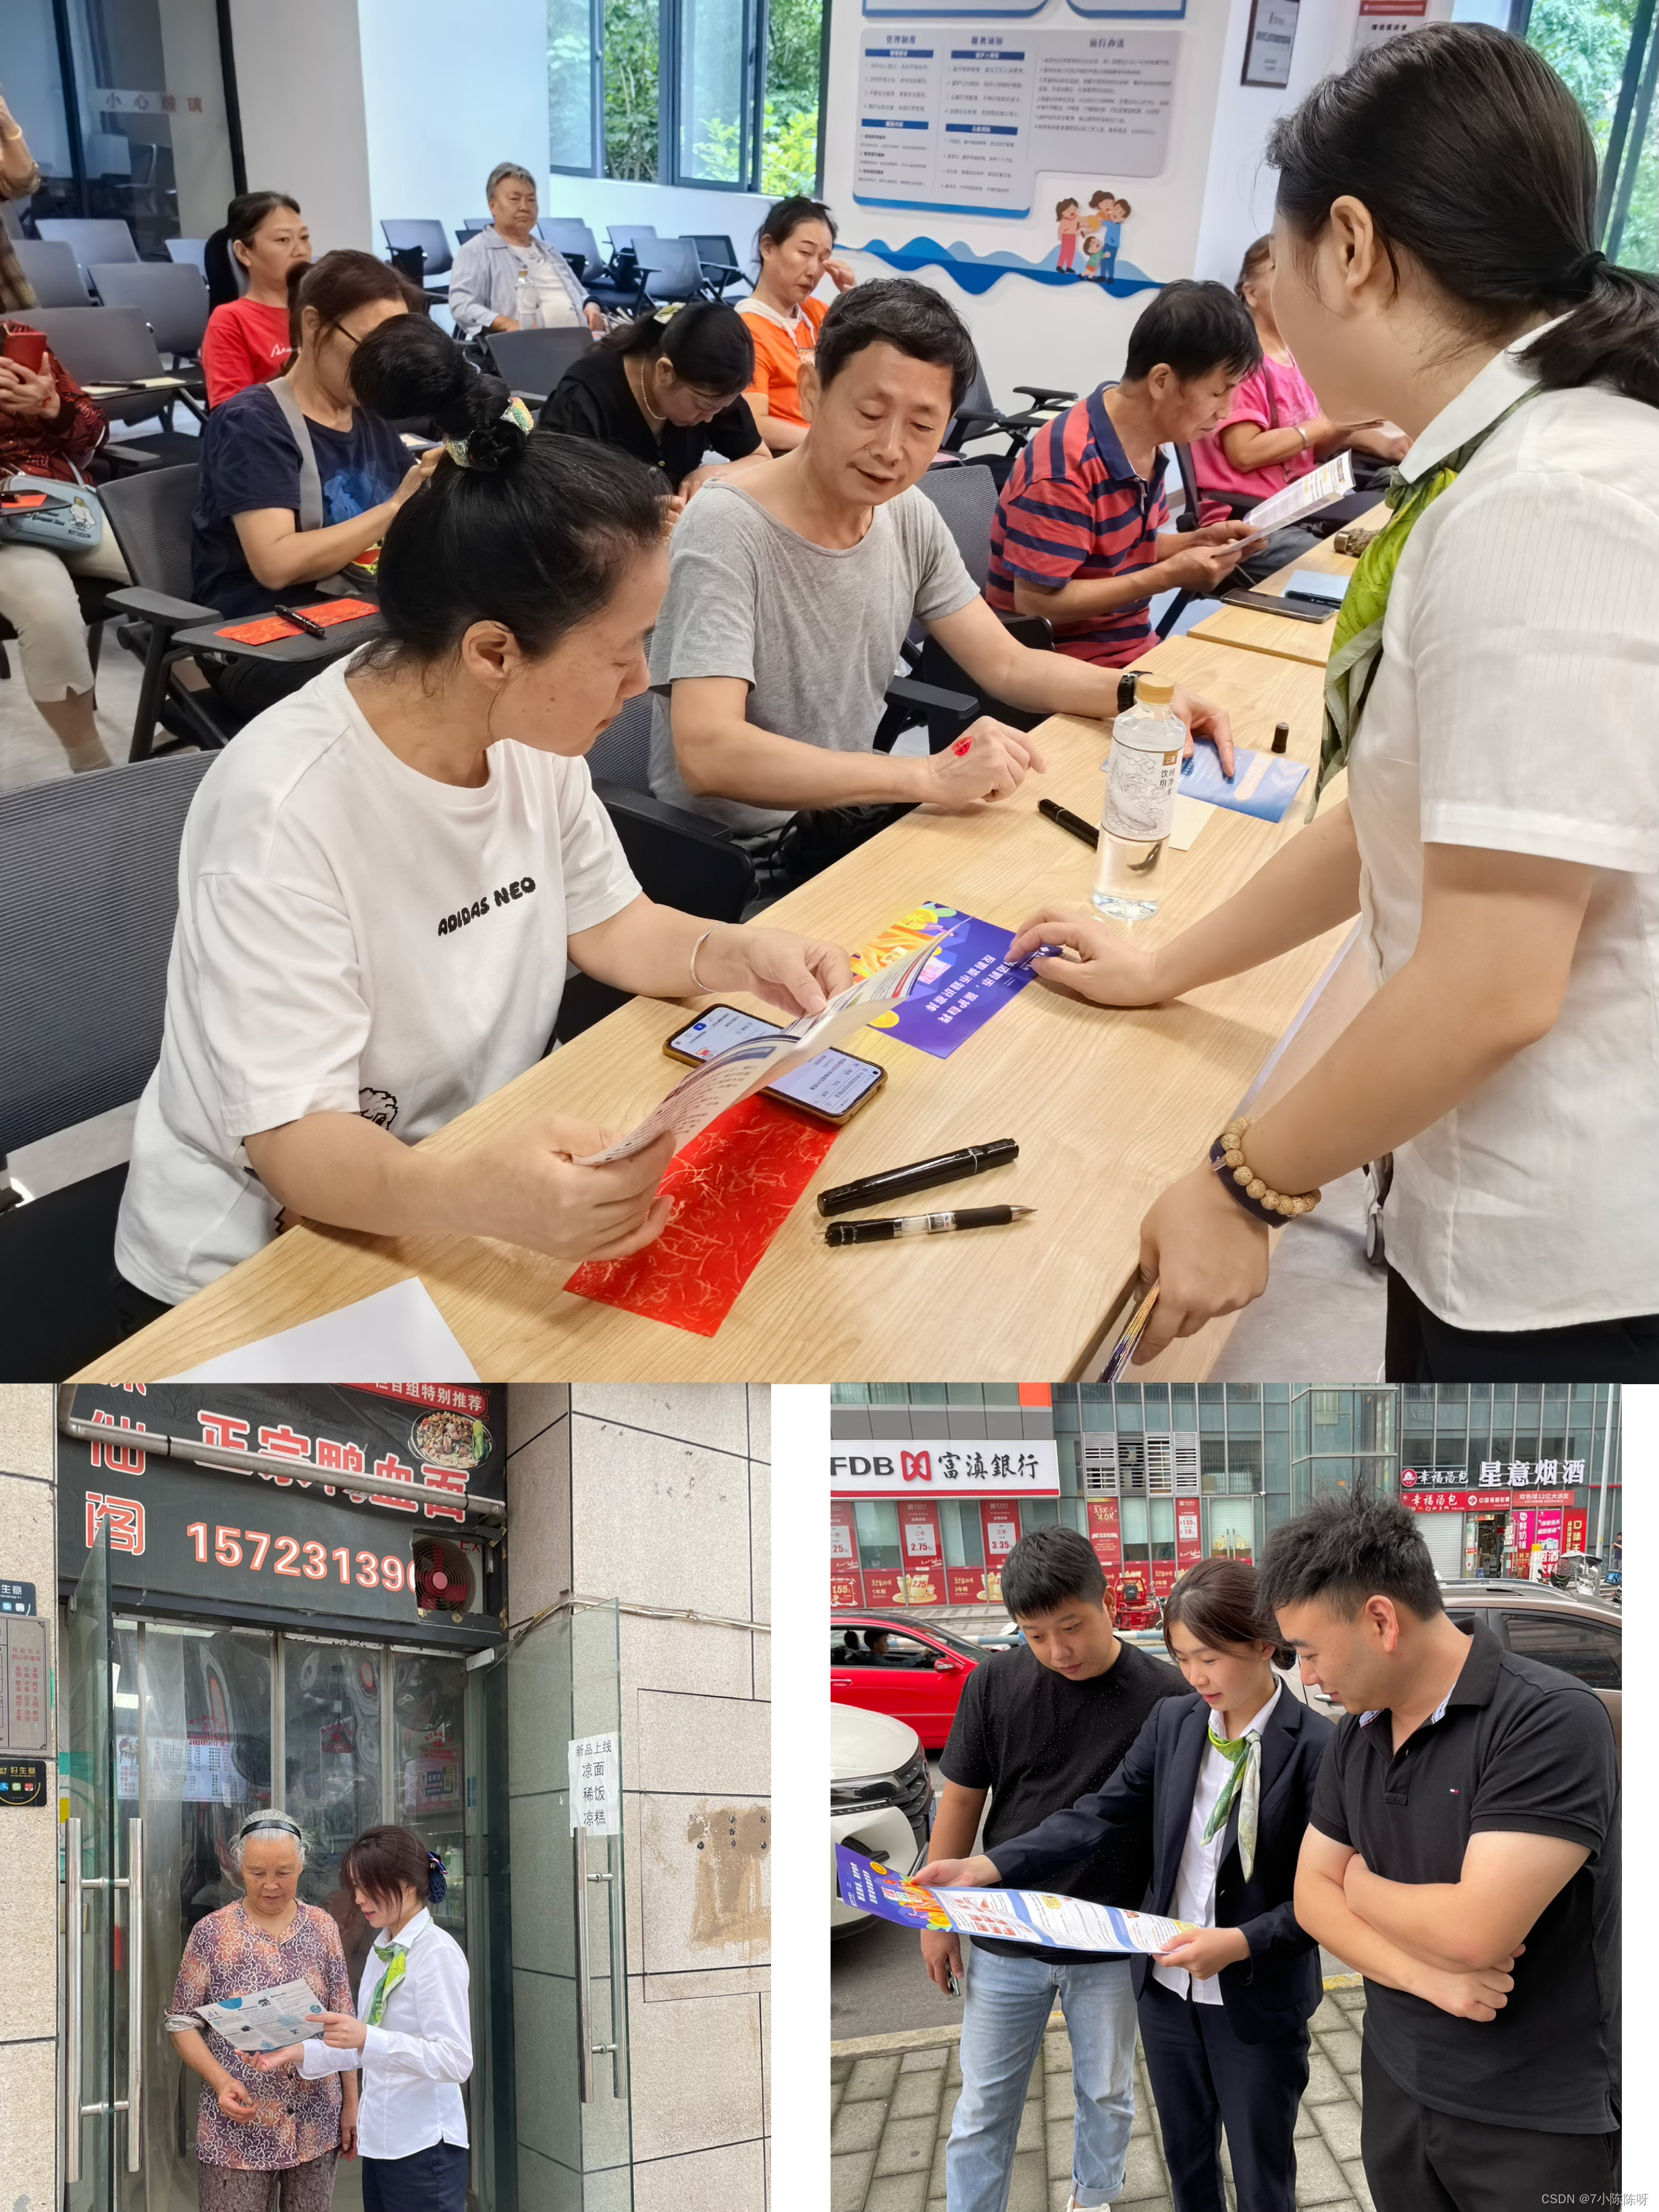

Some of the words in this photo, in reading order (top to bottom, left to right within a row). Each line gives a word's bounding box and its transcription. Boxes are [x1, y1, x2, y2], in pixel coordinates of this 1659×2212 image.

[438, 896, 490, 937] ADIDAS
[494, 876, 536, 907] NEO
[924, 954, 997, 1012] 反假货币知识宣传
[831, 1456, 895, 1476] FDB
[938, 1451, 1039, 1479] 富滇銀行
[1479, 1458, 1585, 1487] 星意烟酒
[1418, 1470, 1469, 1485] 幸福汤包
[1412, 1493, 1458, 1506] 幸福汤包
[1572, 1520, 1583, 1551] 口味王
[576, 1739, 612, 1758] 新品上线
[582, 1761, 605, 1779] 凉面
[583, 1785, 605, 1802] 稀饭
[583, 1809, 606, 1826] 凉糕
